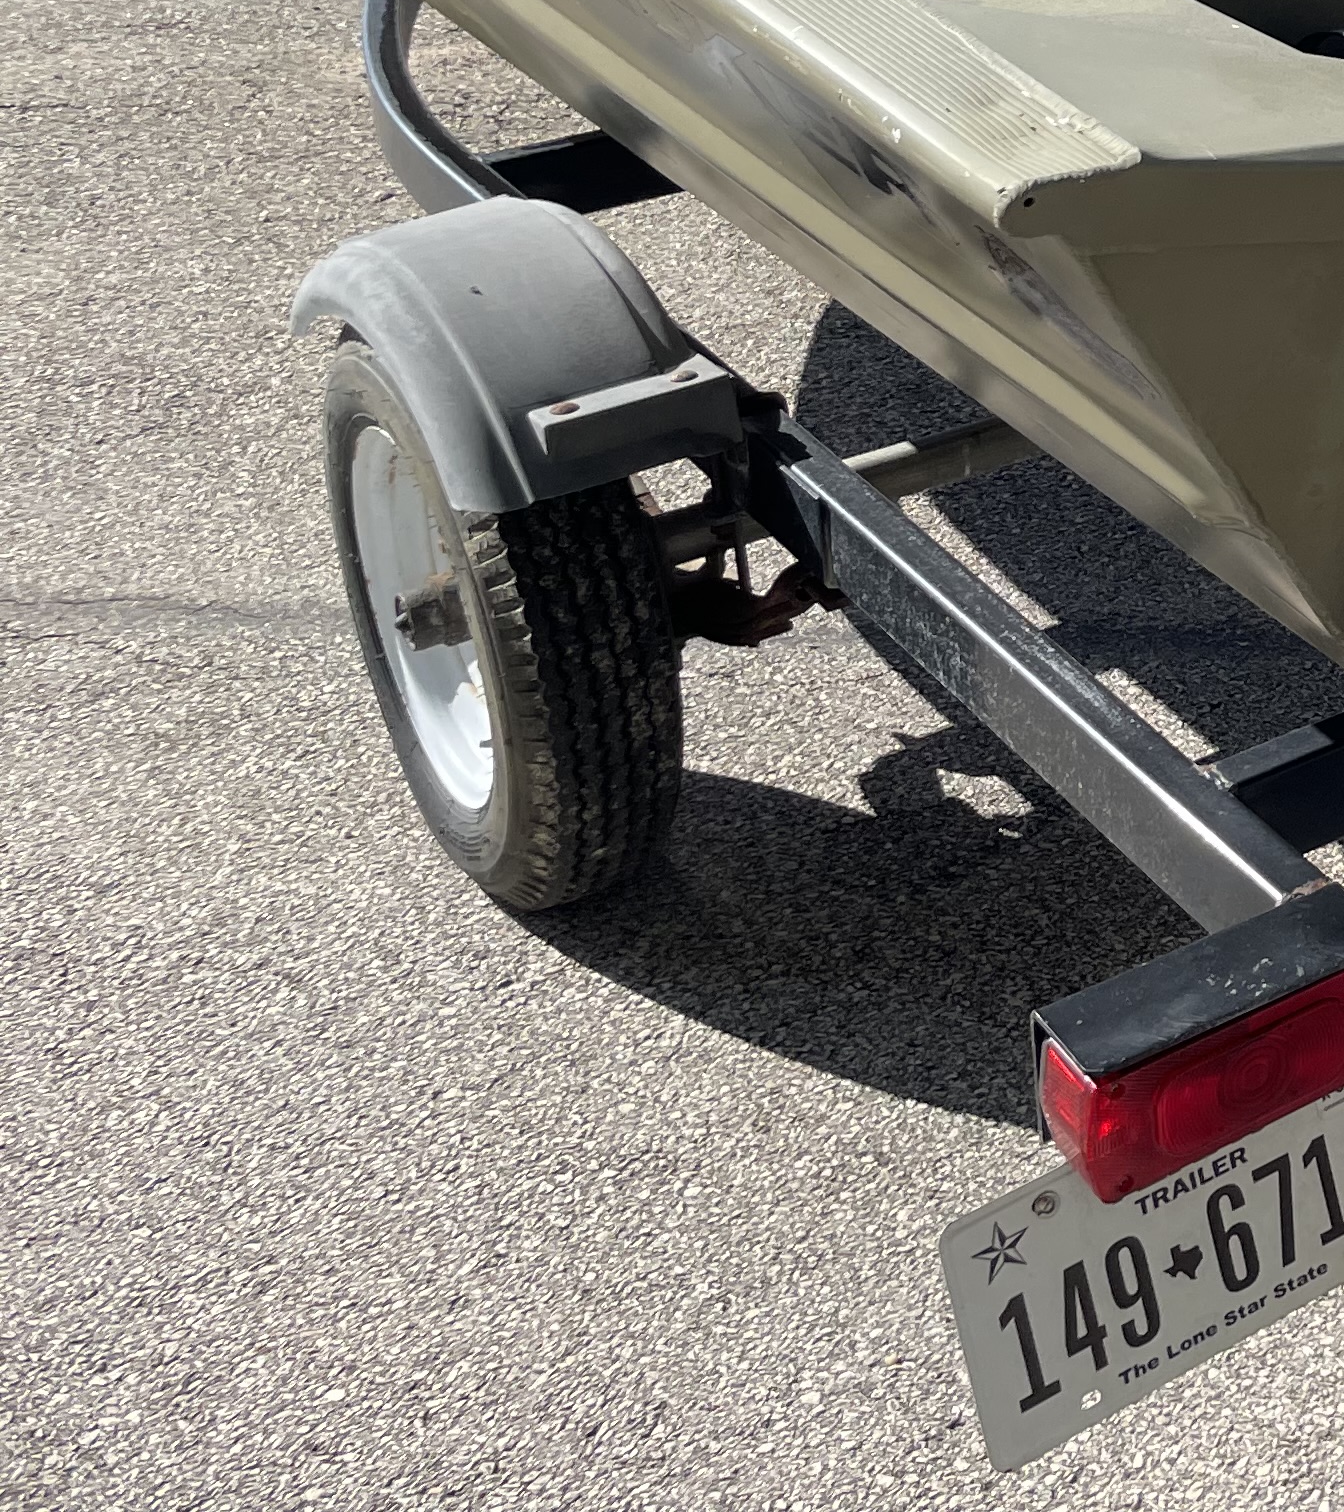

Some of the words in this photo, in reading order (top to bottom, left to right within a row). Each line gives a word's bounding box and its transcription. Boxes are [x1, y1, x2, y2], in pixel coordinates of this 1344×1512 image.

[1135, 1147, 1248, 1215] TRAILER
[998, 1236, 1161, 1413] 149
[1118, 1356, 1159, 1384] The
[1166, 1324, 1218, 1359] Lone
[1224, 1295, 1269, 1326] Star
[1273, 1262, 1329, 1298] State
